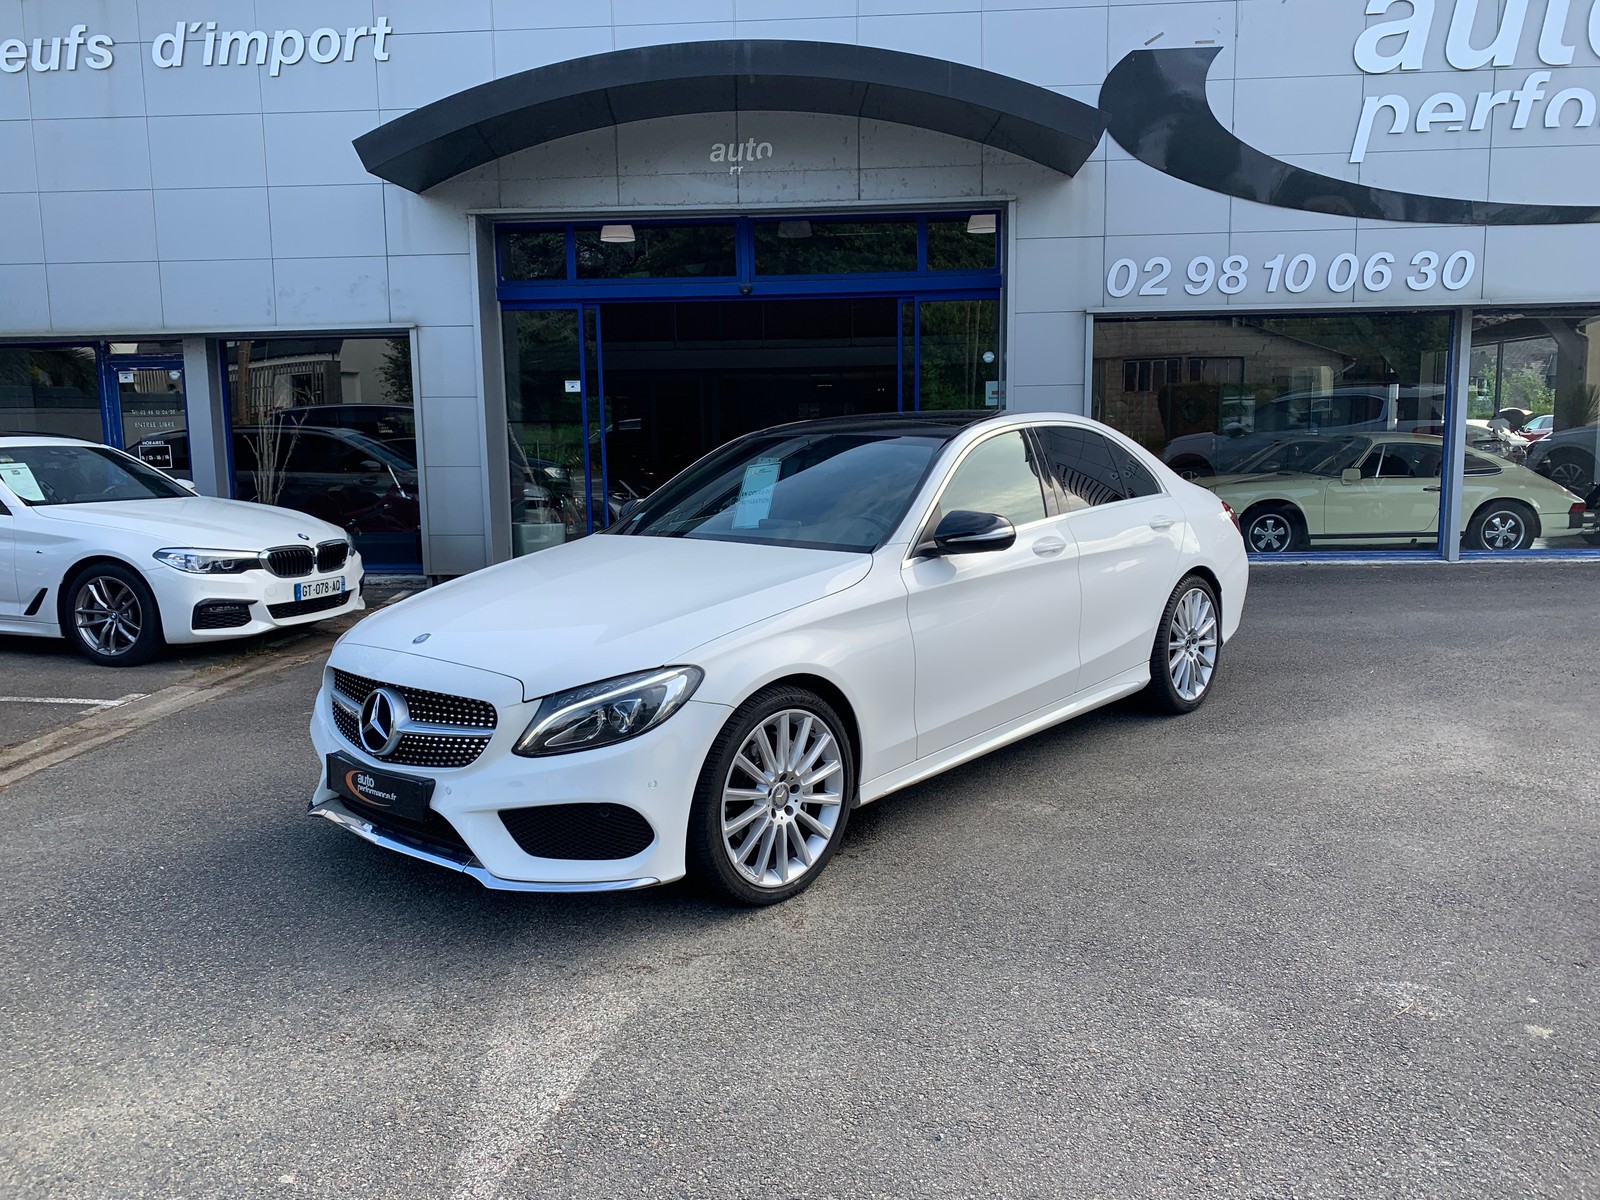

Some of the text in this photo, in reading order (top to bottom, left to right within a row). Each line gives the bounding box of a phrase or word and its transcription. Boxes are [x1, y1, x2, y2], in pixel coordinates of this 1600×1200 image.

[0, 16, 393, 77] eufs d'import
[1353, 0, 1600, 74] aut
[709, 137, 773, 162] auto
[1106, 250, 1476, 297] 02 98 10 06 30
[357, 774, 375, 788] auto
